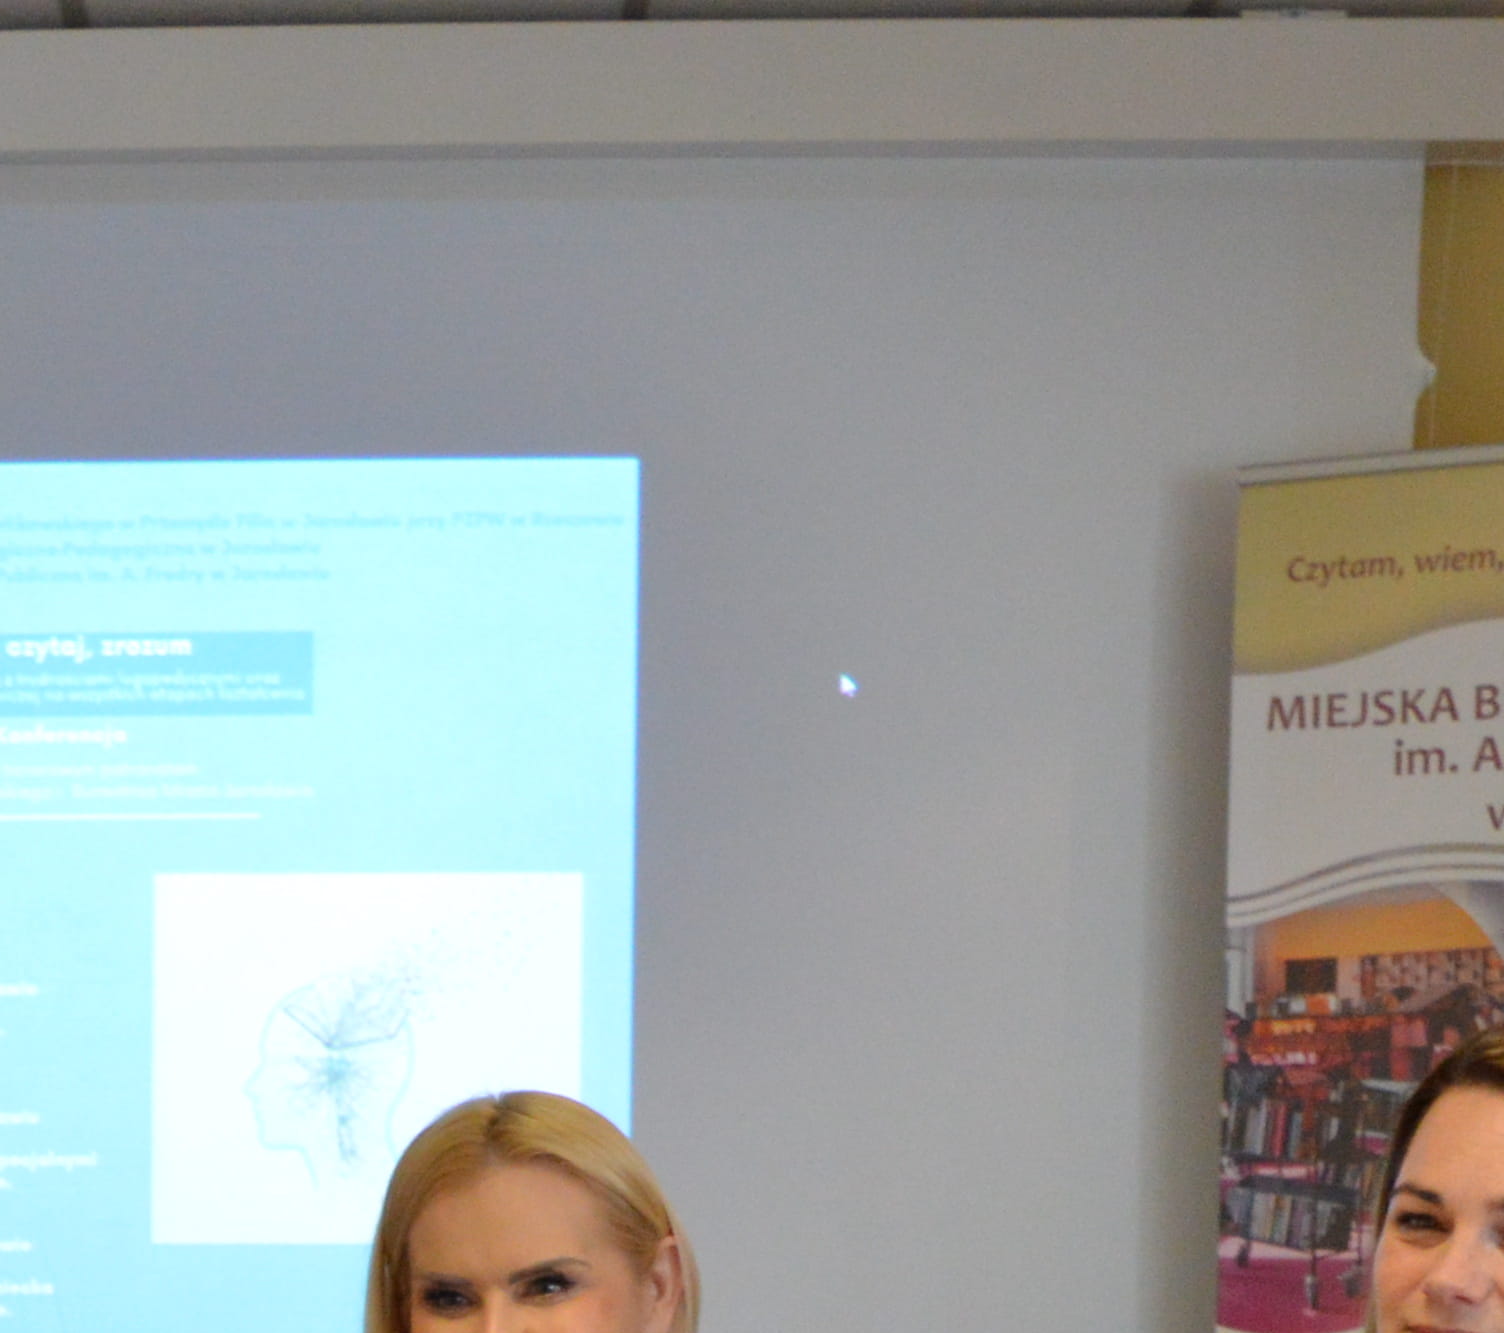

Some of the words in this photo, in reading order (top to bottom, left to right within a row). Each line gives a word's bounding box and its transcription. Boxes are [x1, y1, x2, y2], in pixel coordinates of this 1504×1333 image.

[1286, 548, 1406, 584] Czytam,
[1413, 541, 1504, 576] wiem,
[5, 637, 94, 664] czytaj,
[102, 637, 193, 658] zrozum
[1266, 686, 1460, 732] MIEJSKA
[1393, 737, 1459, 776] im.
